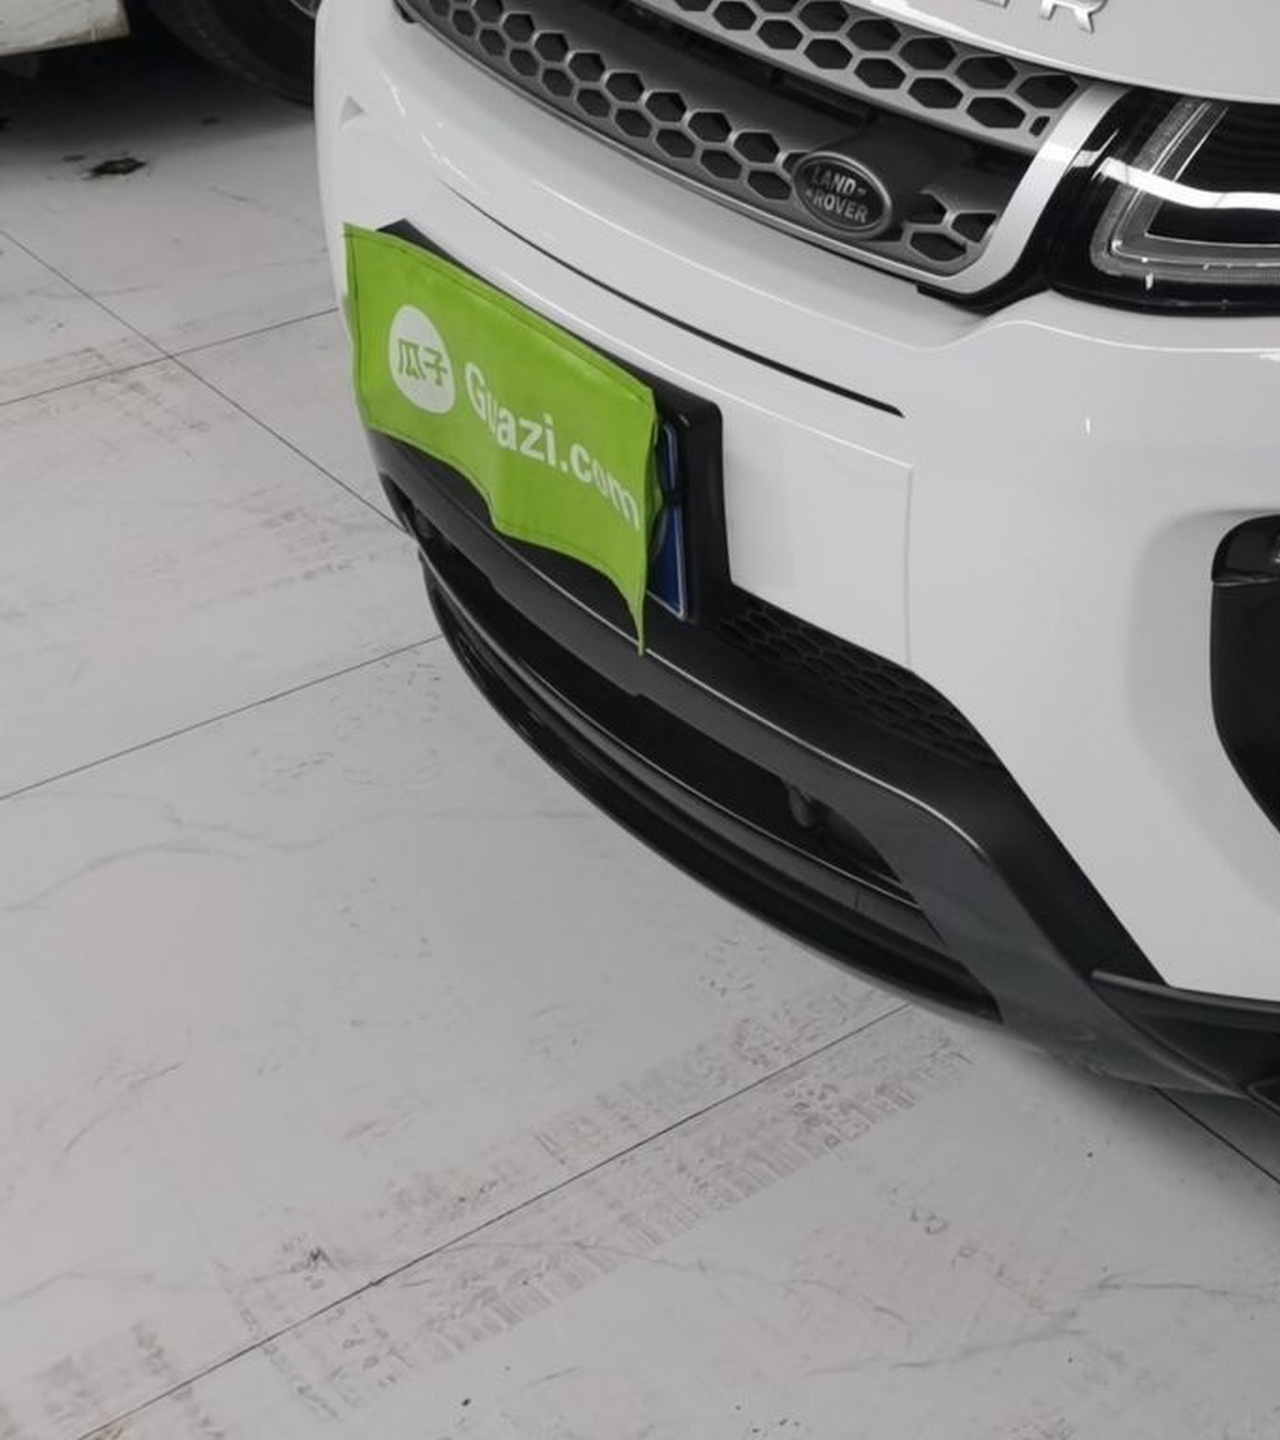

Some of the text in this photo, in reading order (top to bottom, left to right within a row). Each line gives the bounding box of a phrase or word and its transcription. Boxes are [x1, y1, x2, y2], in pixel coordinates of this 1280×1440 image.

[812, 165, 856, 195] LAND
[813, 188, 868, 224] ROVER
[398, 339, 448, 387] 瓜子
[465, 362, 641, 531] Guazi.com
